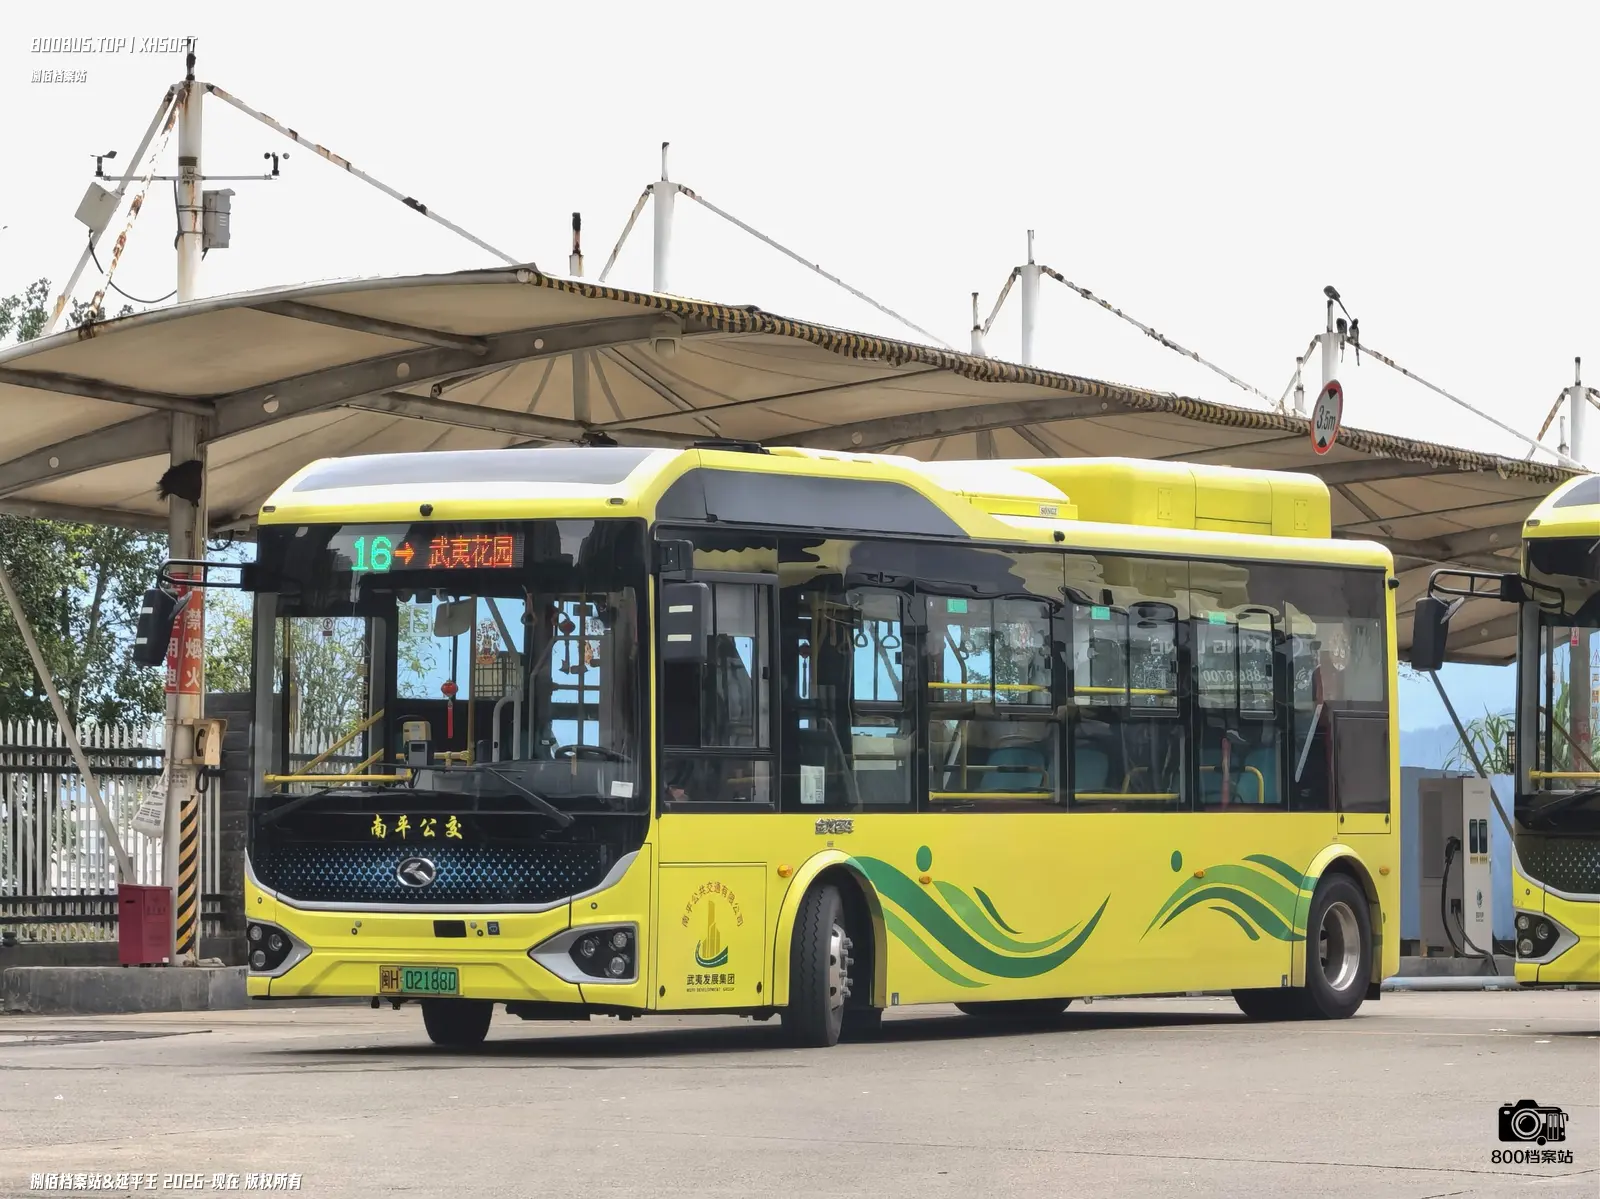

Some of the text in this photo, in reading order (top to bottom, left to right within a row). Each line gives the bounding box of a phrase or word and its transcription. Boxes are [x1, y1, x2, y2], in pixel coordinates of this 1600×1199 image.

[1317, 405, 1336, 431] 3.5m
[351, 535, 513, 571] 16 武夷花园
[371, 814, 463, 840] 南平公交
[686, 973, 735, 986] 武夷发展集团
